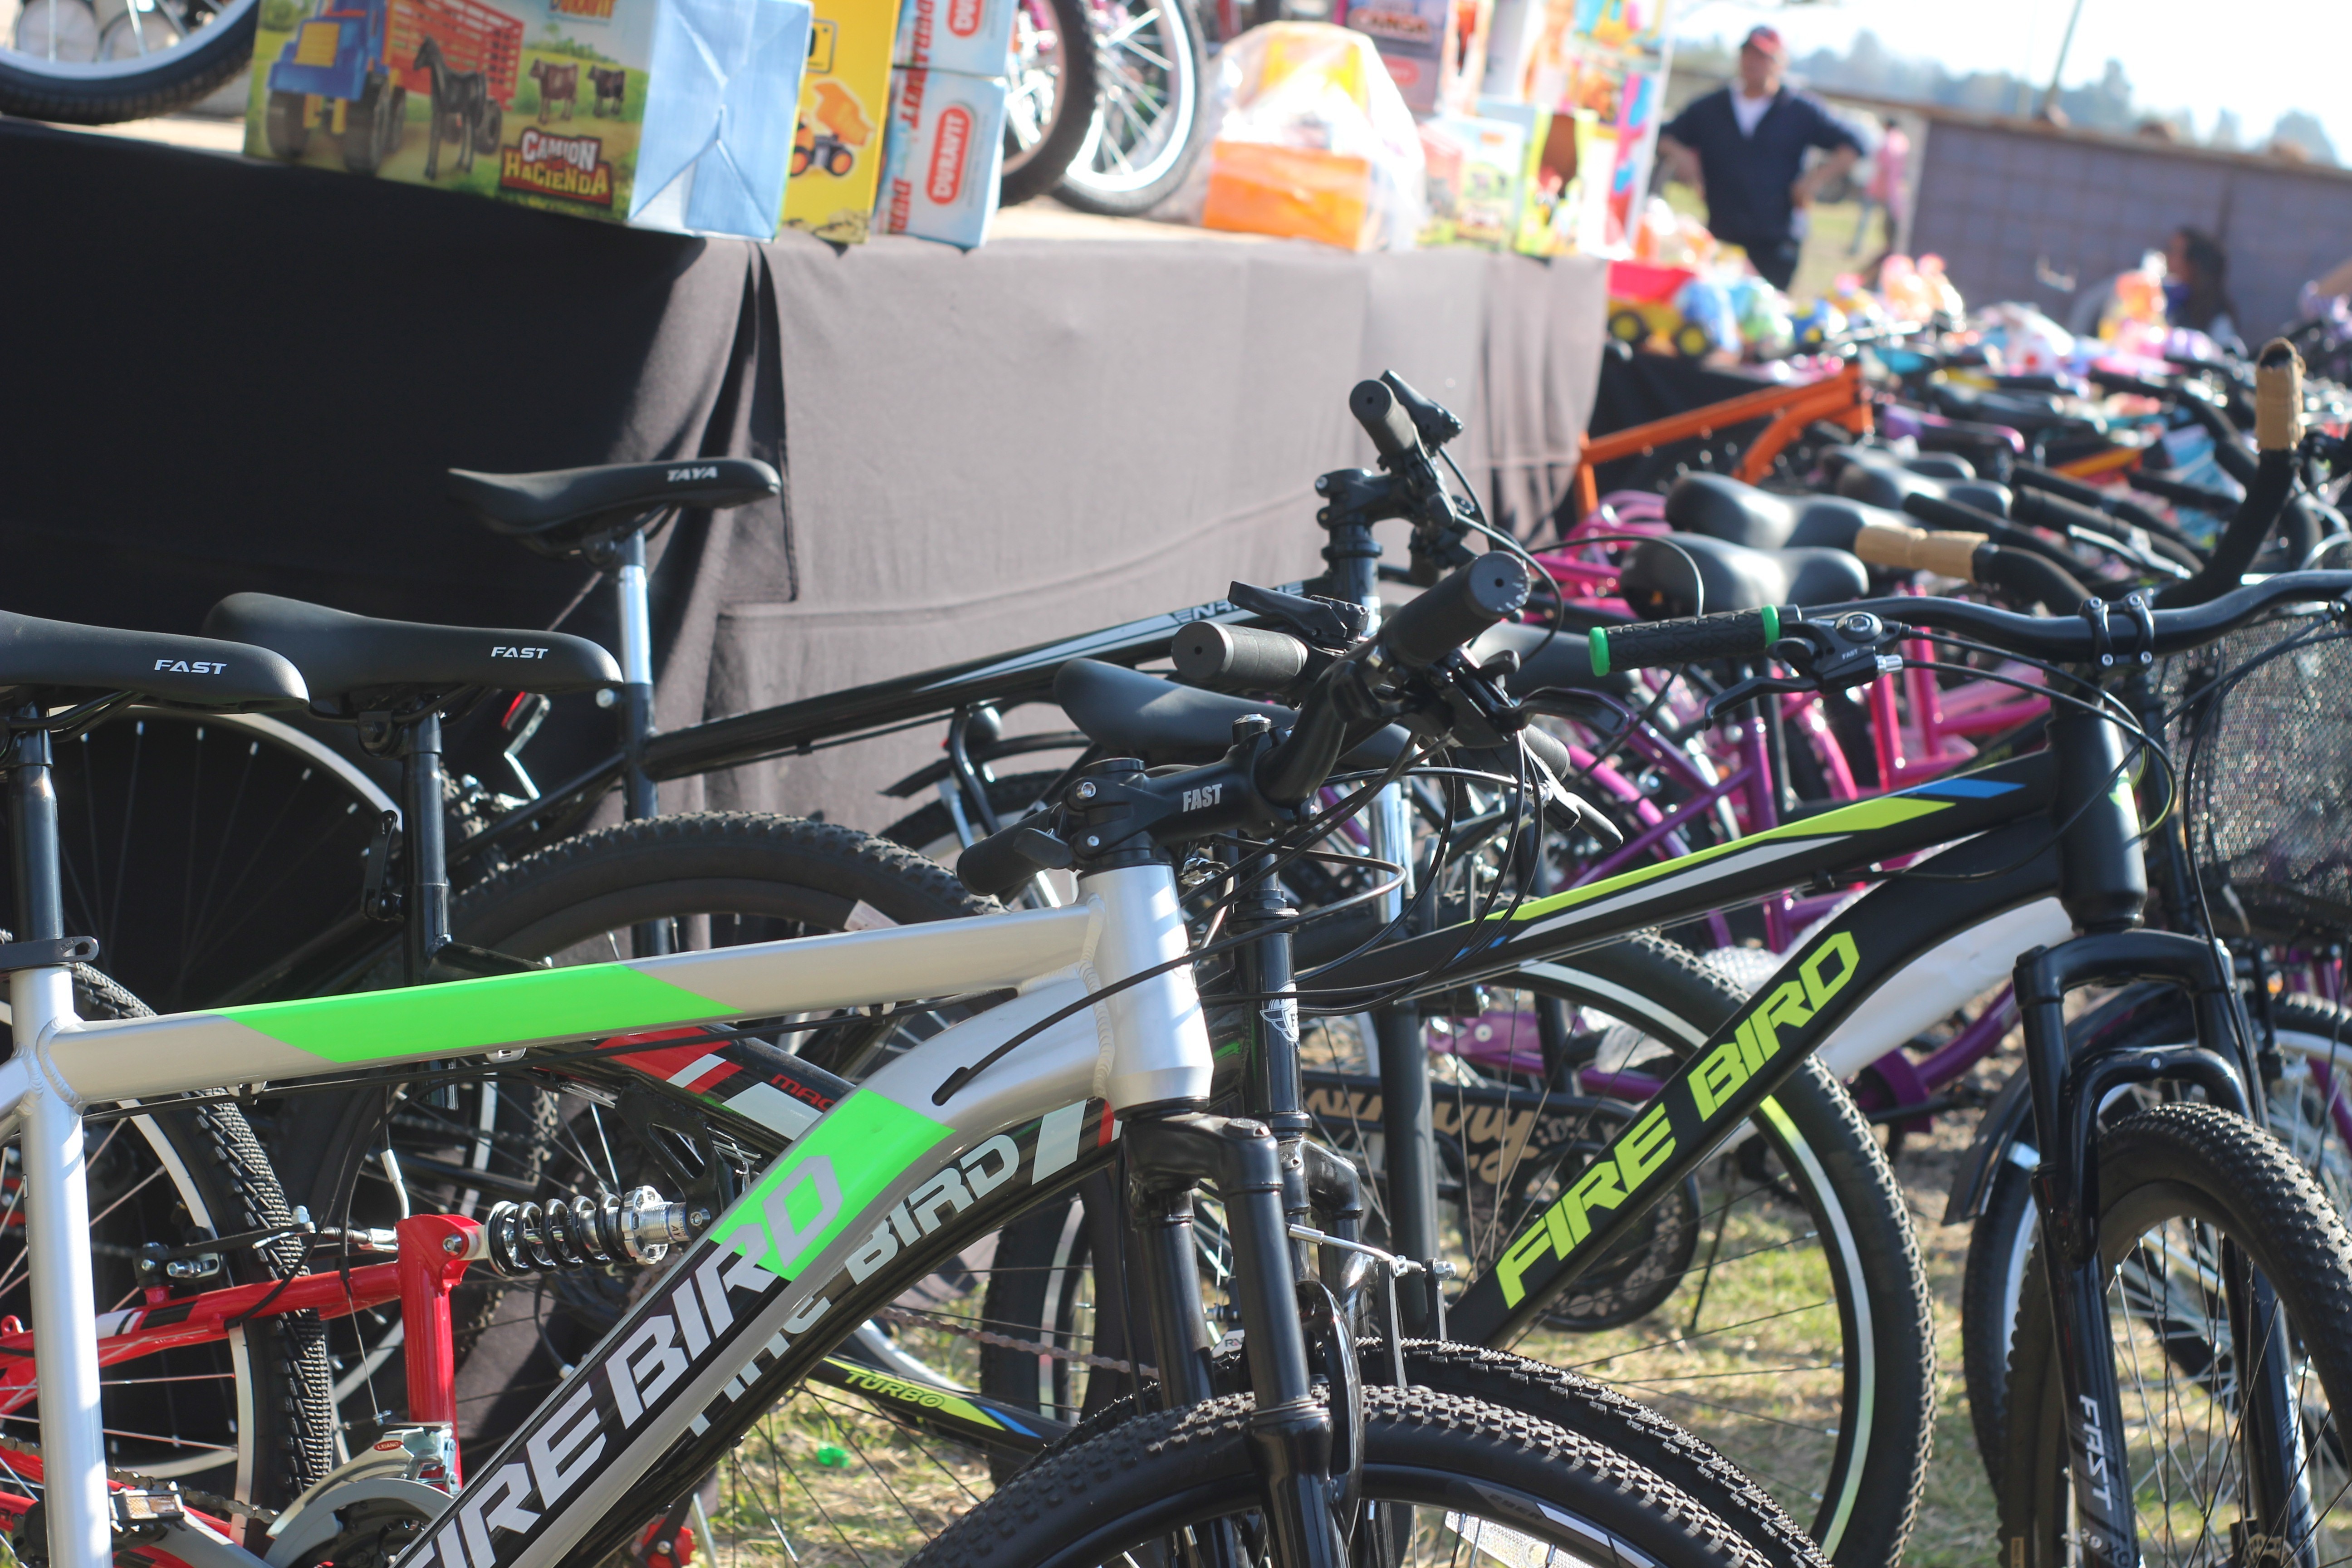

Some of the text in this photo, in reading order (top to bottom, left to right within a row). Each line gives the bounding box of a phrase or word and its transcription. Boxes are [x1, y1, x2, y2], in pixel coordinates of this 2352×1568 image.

[522, 129, 598, 172] CAMION
[932, 113, 966, 199] DURAVIT
[504, 150, 608, 196] HACIENDA
[666, 466, 718, 482] TAYA
[154, 659, 227, 675] FAST
[490, 646, 549, 659] FAST
[1182, 783, 1223, 813] FAST
[1496, 1102, 1677, 1309] FIRE
[1687, 931, 1860, 1122] BIRD
[605, 1155, 844, 1430] BIRD
[844, 1370, 945, 1408] TURBO
[2079, 1394, 2112, 1511] FAST
